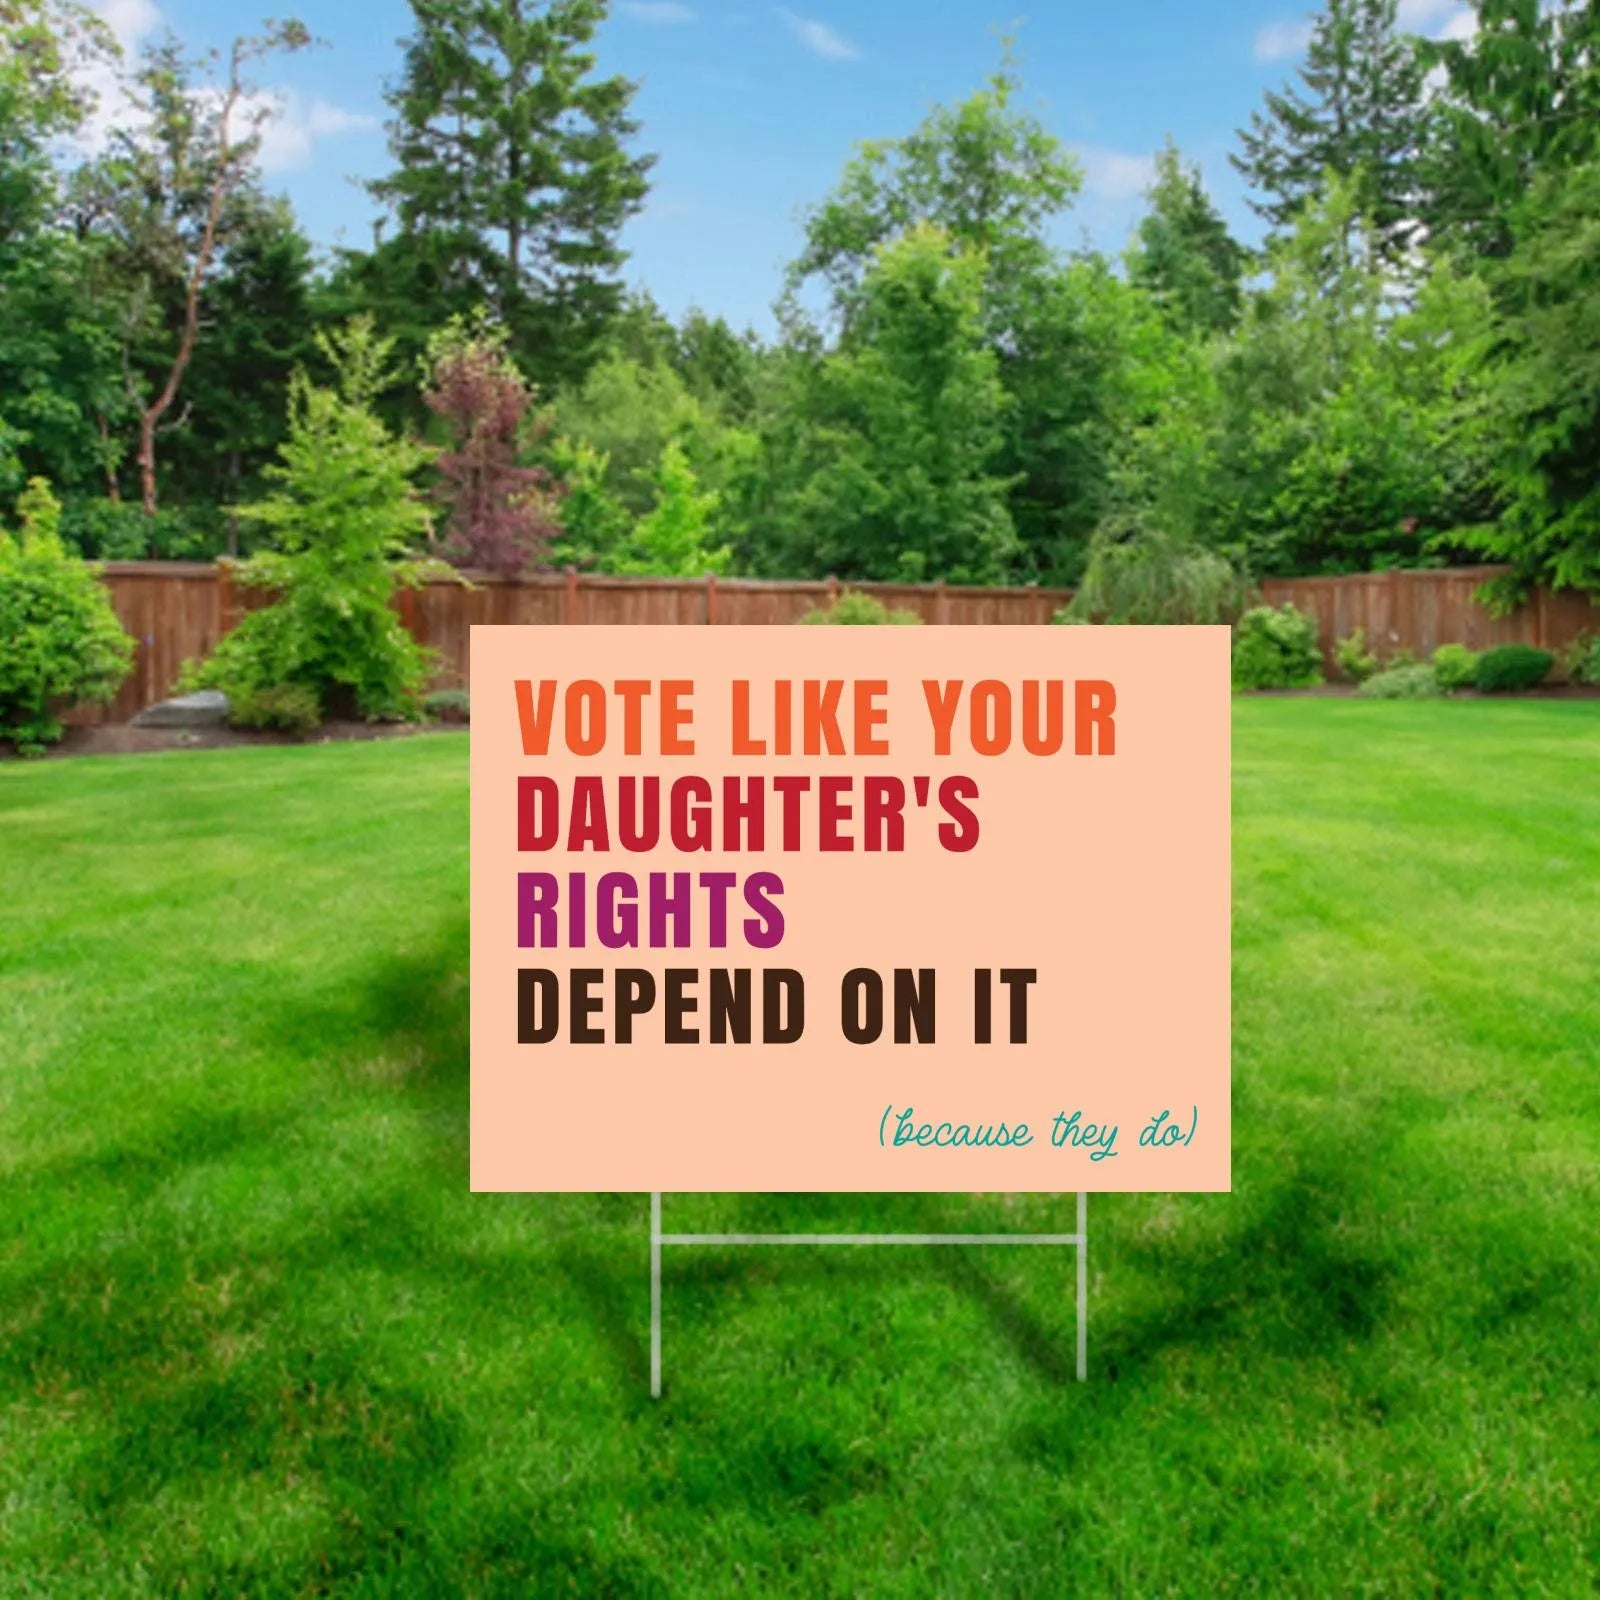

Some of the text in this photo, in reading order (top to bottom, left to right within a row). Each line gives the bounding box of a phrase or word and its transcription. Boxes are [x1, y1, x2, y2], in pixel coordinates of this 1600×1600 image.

[514, 680, 1118, 756] VOTE LIKE YOUR
[518, 776, 980, 852] DAUGHTER'S
[518, 872, 785, 949] RIGHTS
[518, 968, 1037, 1045] DEPEND ON IT
[880, 1105, 1198, 1161] (because they do)
